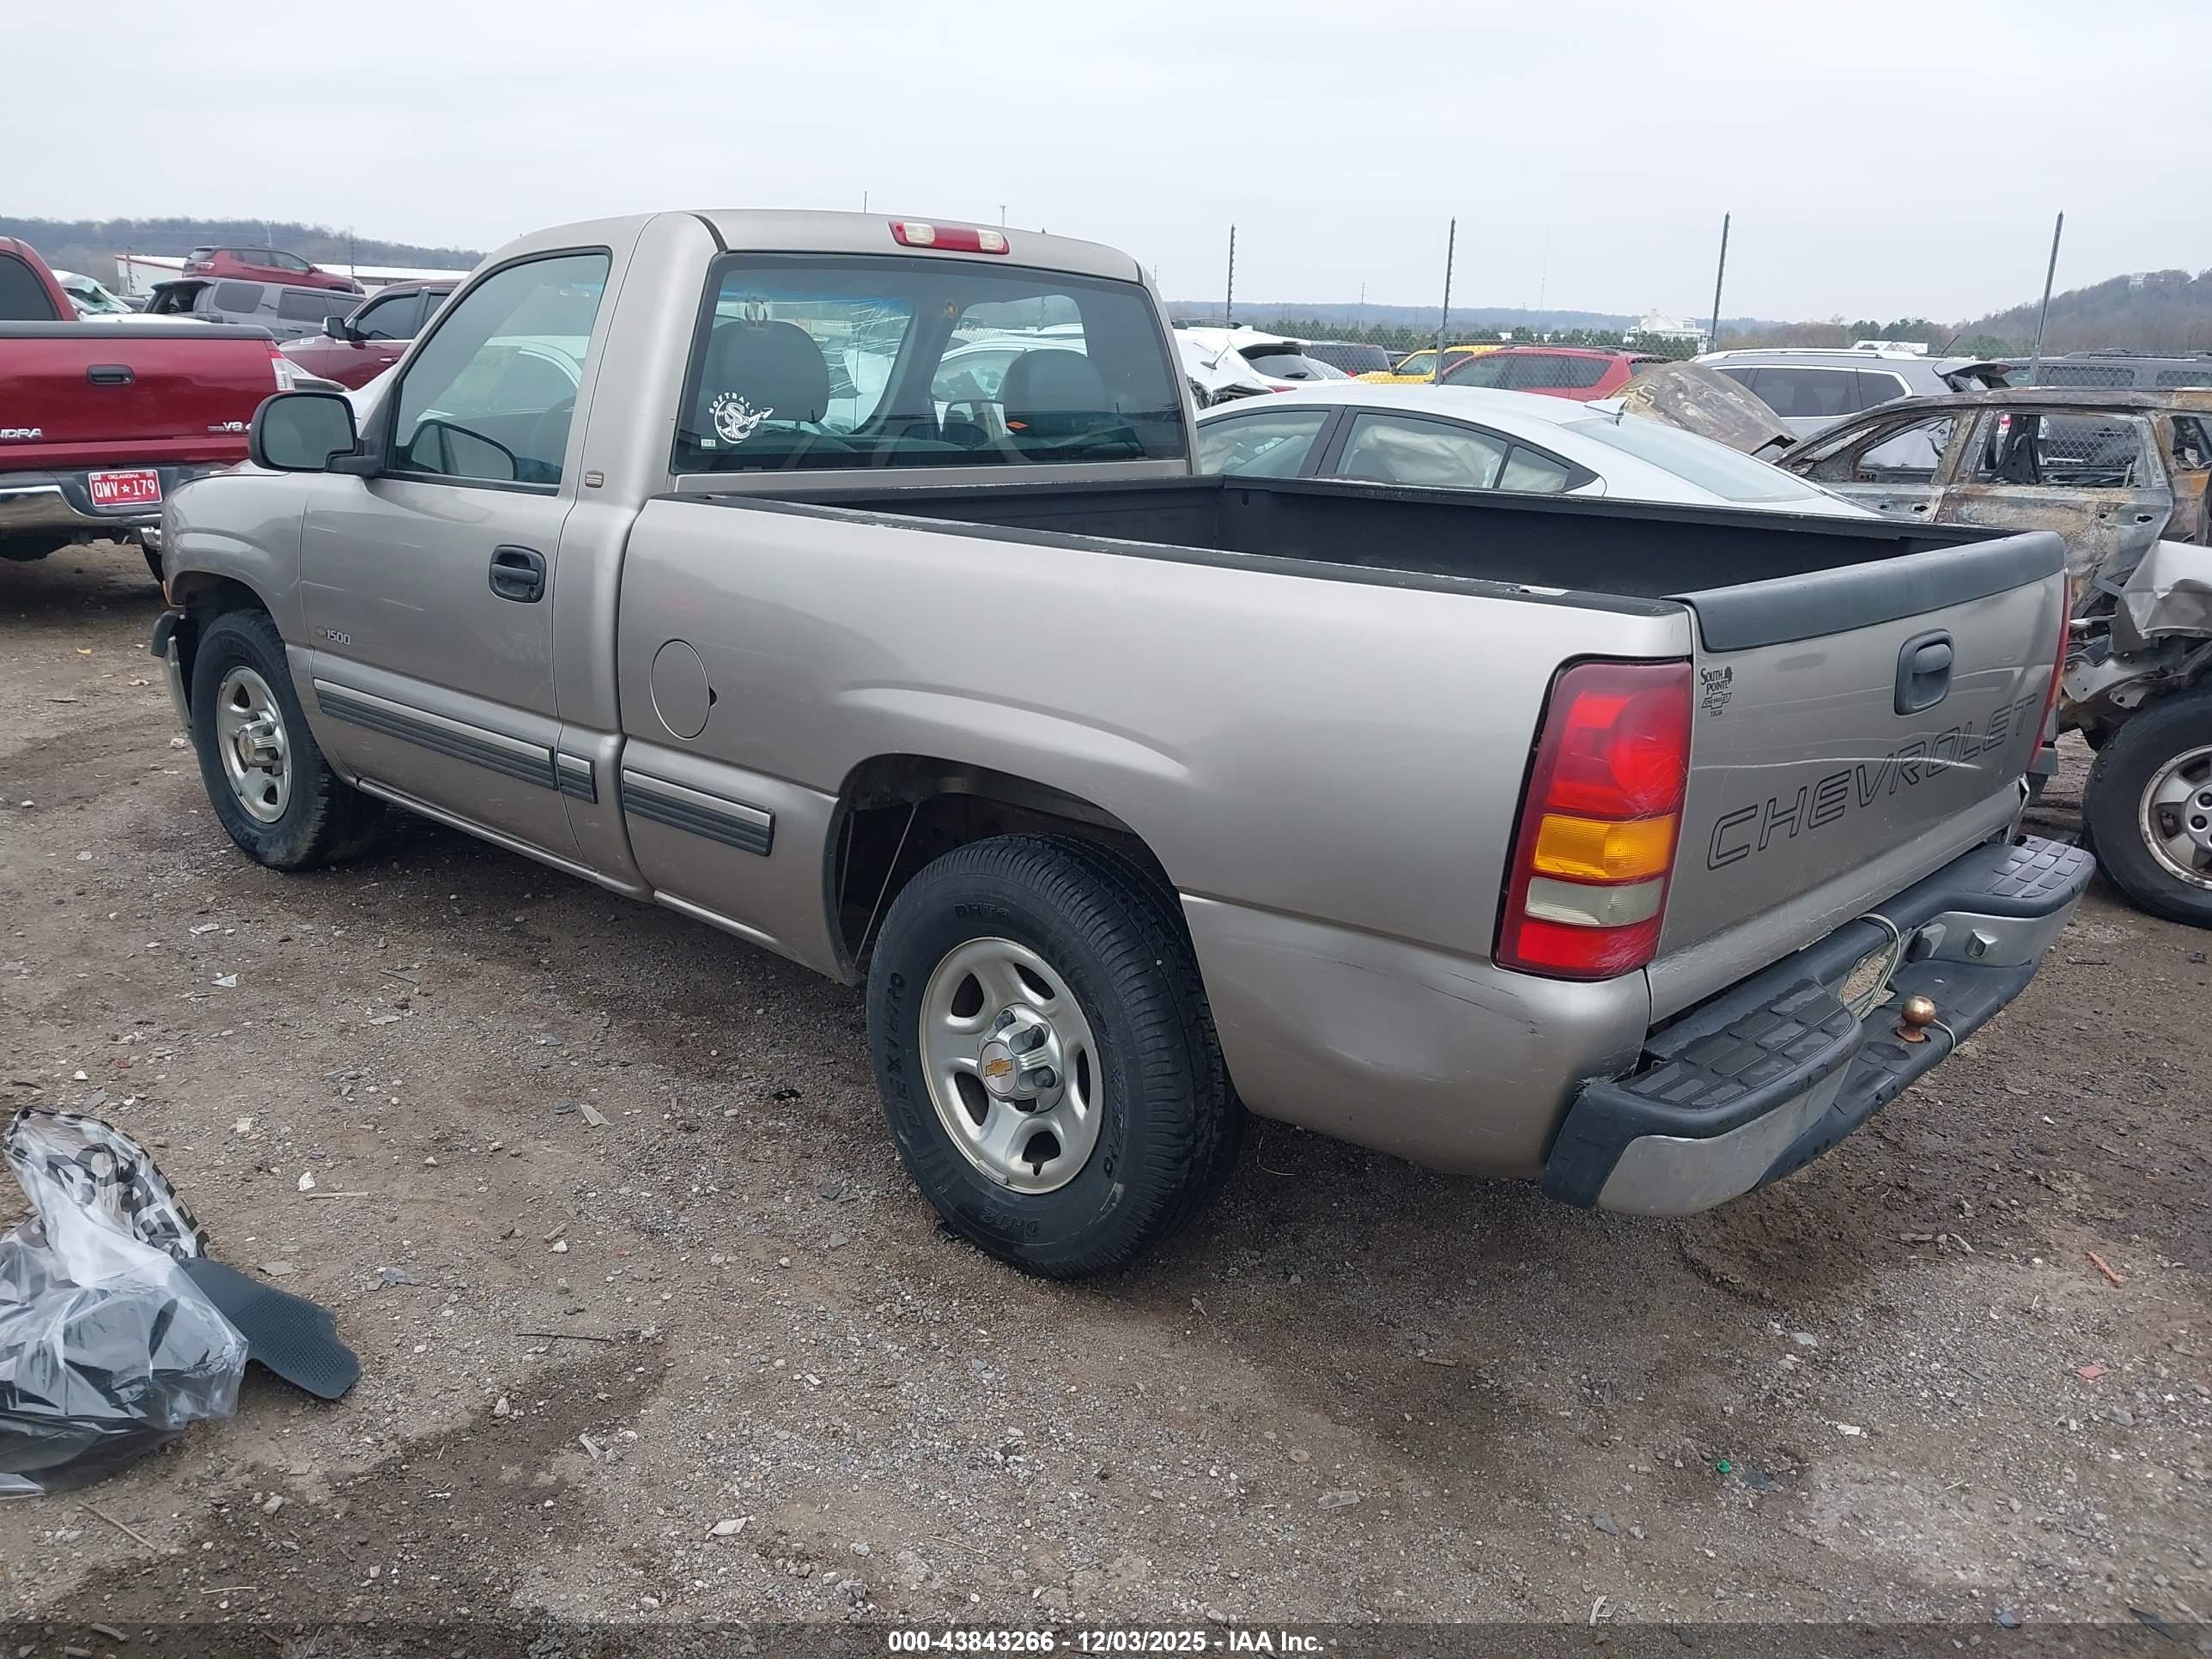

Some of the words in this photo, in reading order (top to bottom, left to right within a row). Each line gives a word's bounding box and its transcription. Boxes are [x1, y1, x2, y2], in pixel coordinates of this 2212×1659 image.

[709, 392, 754, 415] SOFTBALL
[94, 481, 118, 498] QWV
[132, 479, 155, 495] 179
[326, 629, 350, 645] 1500
[1700, 667, 1723, 685] SOUTH
[1706, 693, 2038, 871] CHEVROLET
